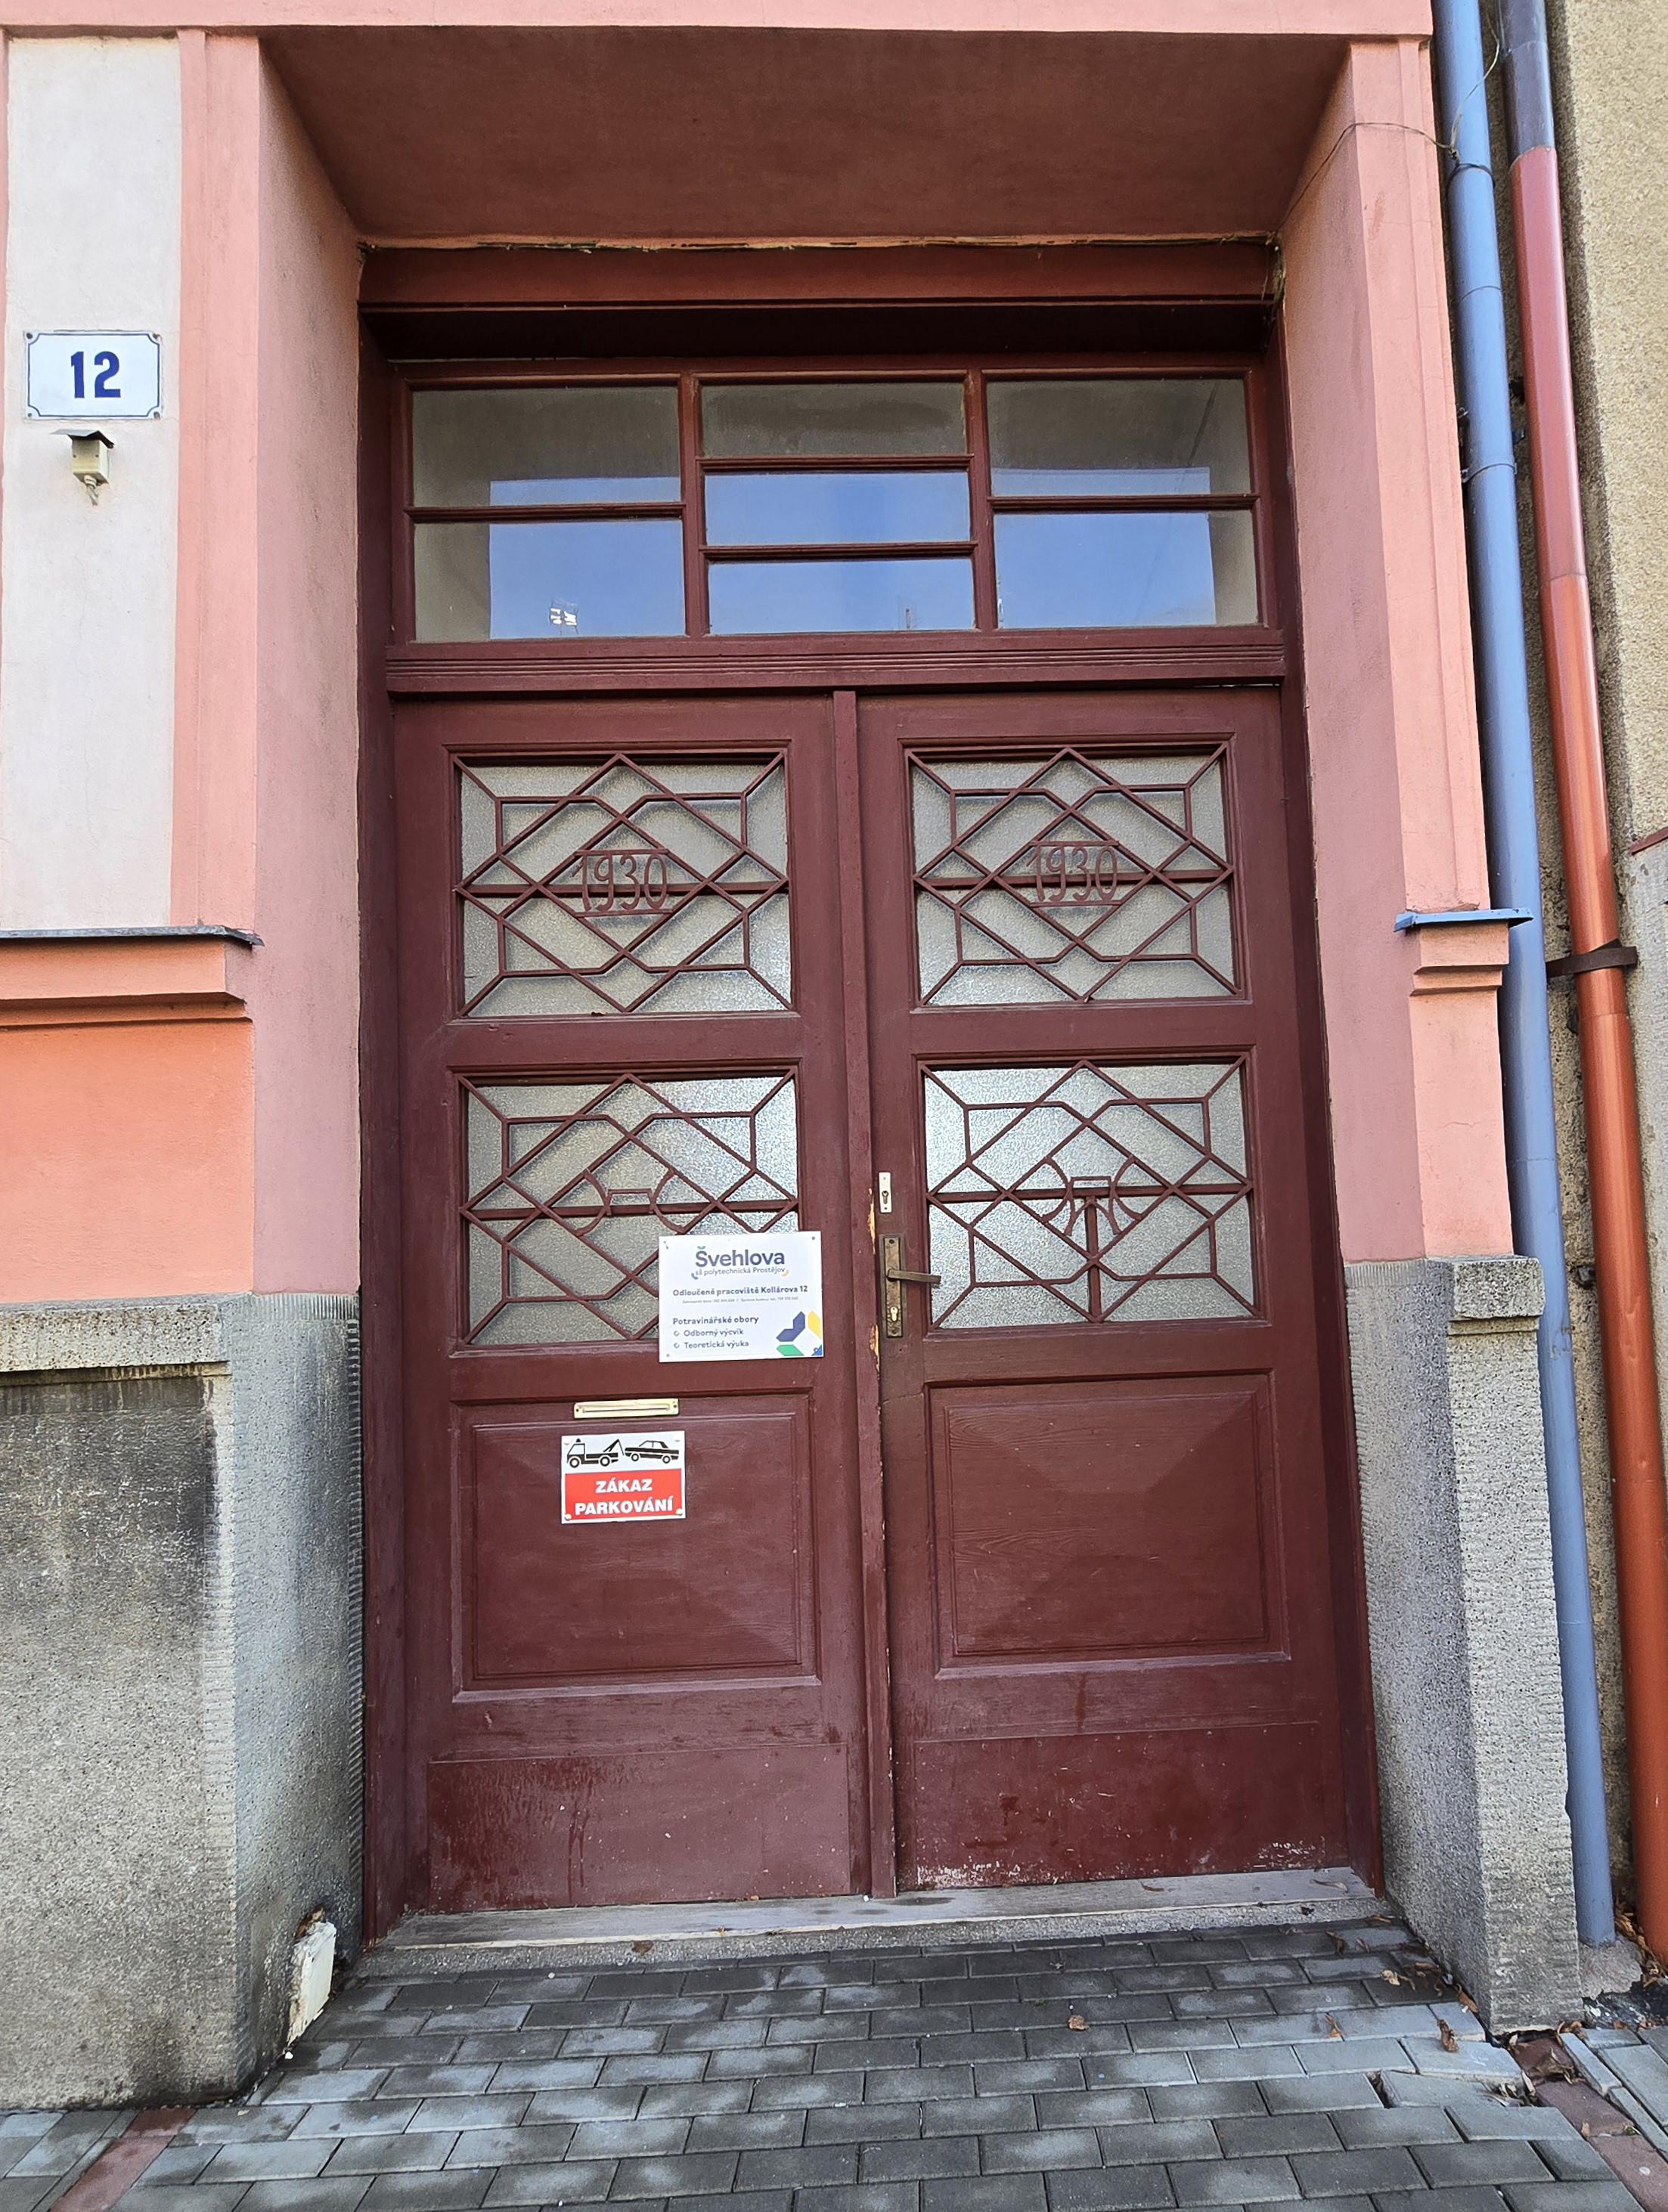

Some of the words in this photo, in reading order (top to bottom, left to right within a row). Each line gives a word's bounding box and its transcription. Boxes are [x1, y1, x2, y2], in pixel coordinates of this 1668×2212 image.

[70, 351, 121, 398] 12
[1026, 845, 1118, 902] 1930
[572, 854, 667, 912] 1930
[695, 1246, 785, 1267] Švehlova
[704, 1268, 751, 1277] polytechnická
[753, 1266, 786, 1275] Prostějov
[673, 1288, 715, 1297] Odloučené
[717, 1287, 759, 1297] pracoviště
[673, 1315, 732, 1324] Potravinářské
[734, 1315, 759, 1324] obory
[684, 1329, 718, 1337] Odborný
[720, 1328, 744, 1337] výcvík
[684, 1340, 724, 1349] Teoretická
[727, 1340, 749, 1349] výuka
[595, 1477, 653, 1494] ZÁKAZ
[575, 1495, 674, 1515] PARKOVÁNÍ
